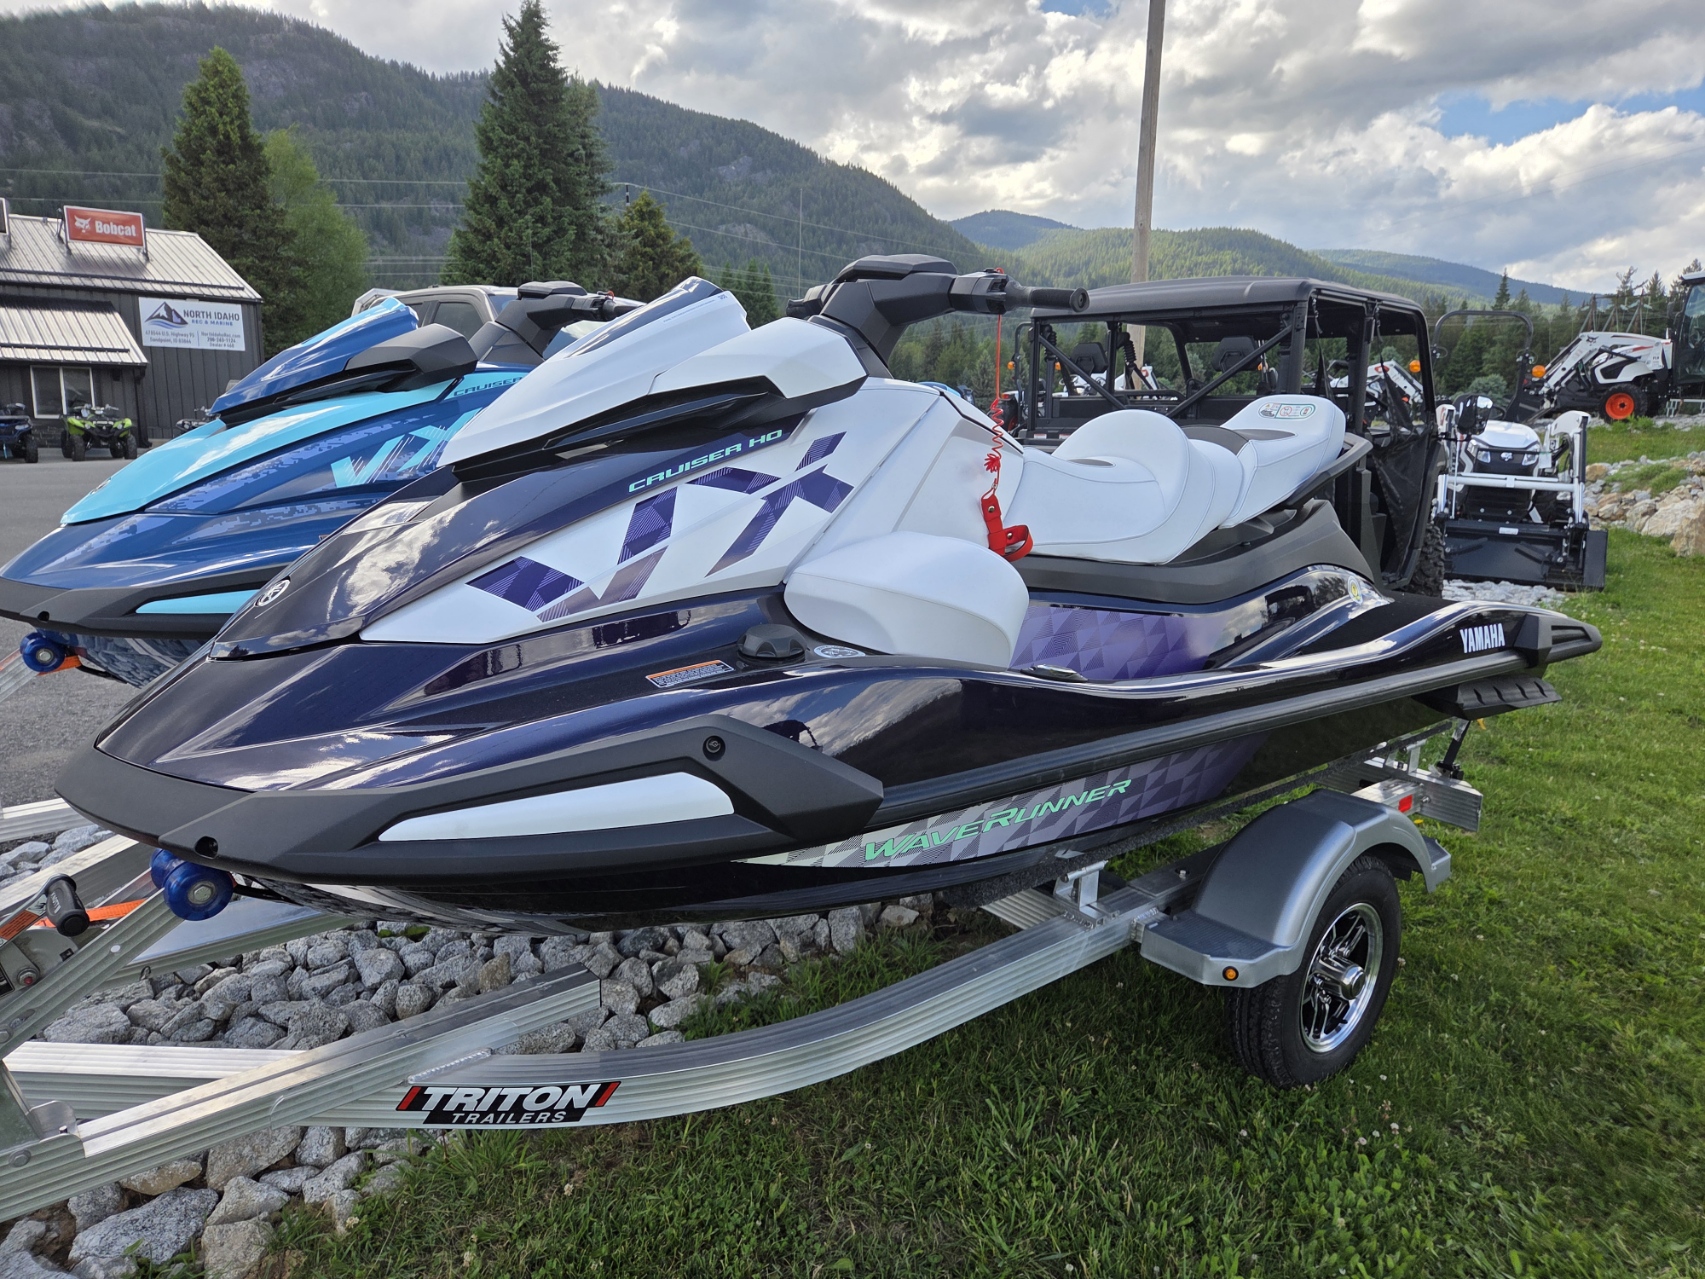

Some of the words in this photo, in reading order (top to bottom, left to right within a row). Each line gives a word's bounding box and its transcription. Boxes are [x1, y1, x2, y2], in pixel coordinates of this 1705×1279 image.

[94, 220, 137, 237] Bobcat
[183, 309, 212, 320] NORTH
[214, 311, 240, 321] IDAHO
[628, 442, 742, 493] CRUISER
[749, 429, 783, 448] HO
[1459, 622, 1506, 654] YAMAHA
[421, 1083, 602, 1111] TRITON
[452, 1111, 567, 1124] TRAILERS
